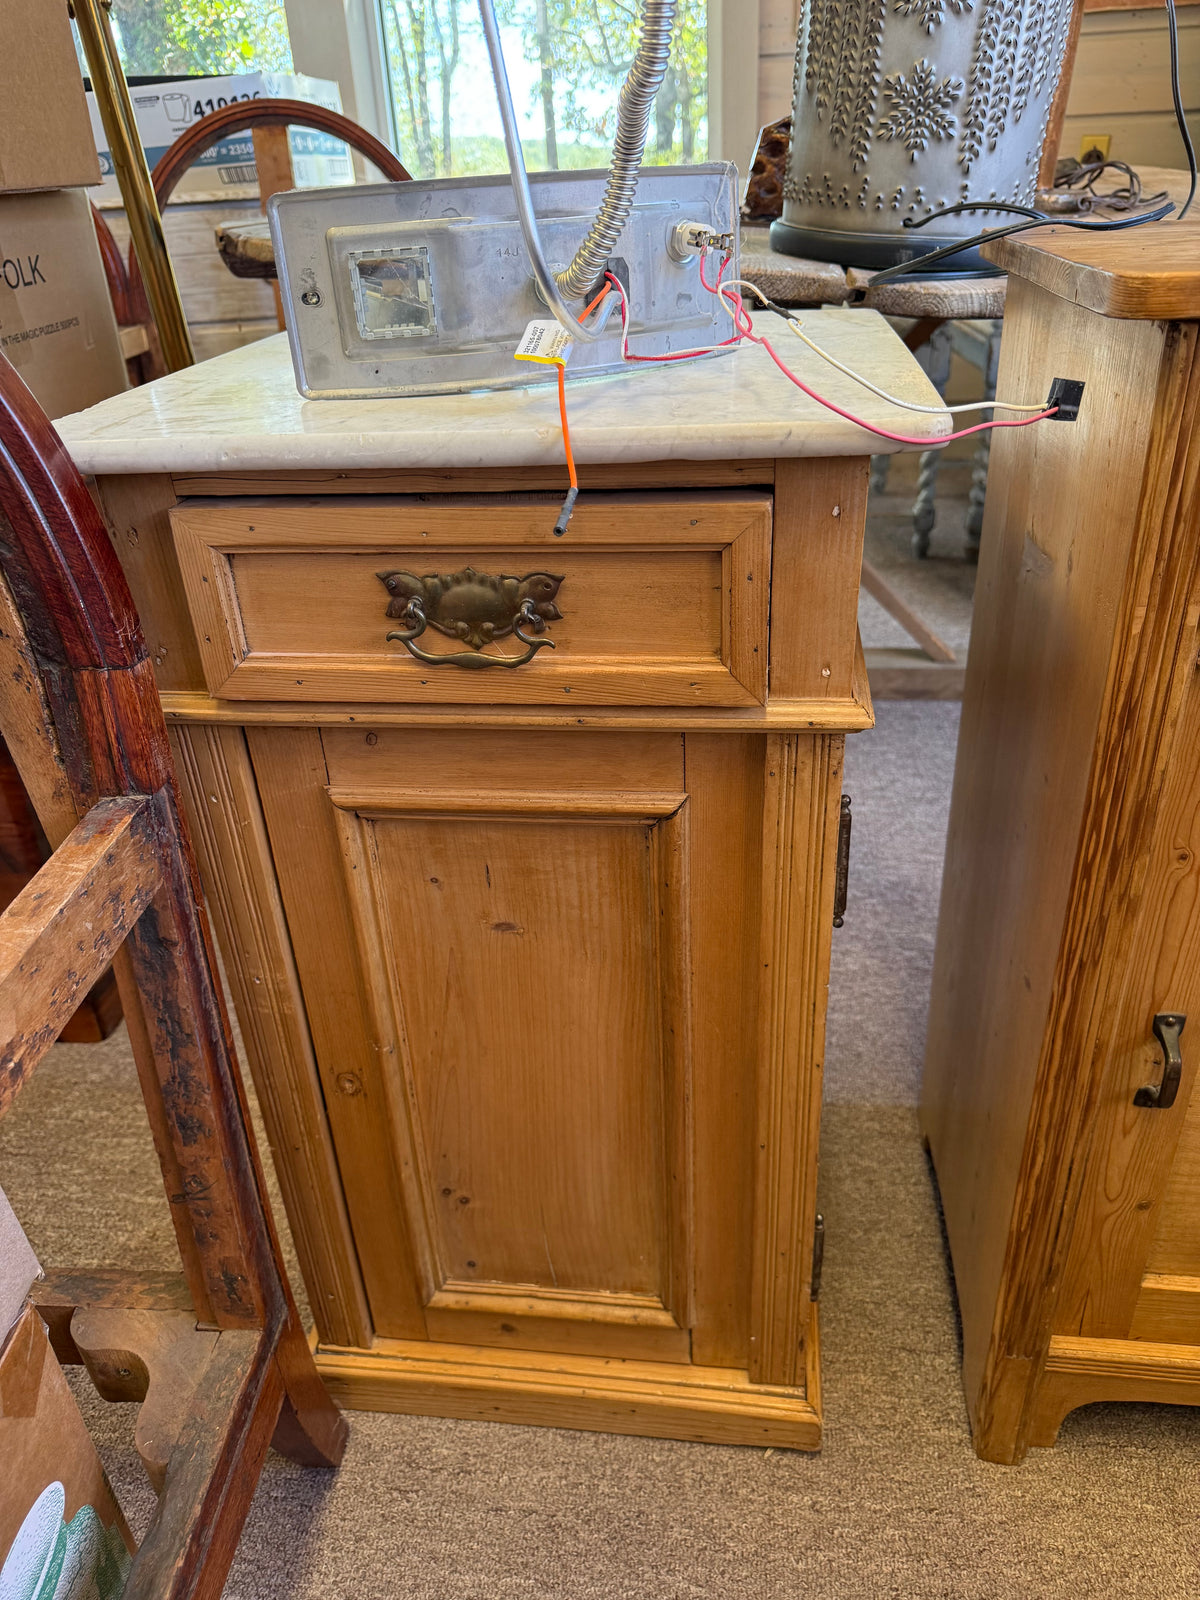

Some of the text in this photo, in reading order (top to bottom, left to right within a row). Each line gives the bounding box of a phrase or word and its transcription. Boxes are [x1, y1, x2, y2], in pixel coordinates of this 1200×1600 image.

[0, 254, 46, 289] OLK
[8, 332, 20, 344] THE
[20, 328, 39, 341] MAGIC
[39, 322, 60, 336] PUZZLE
